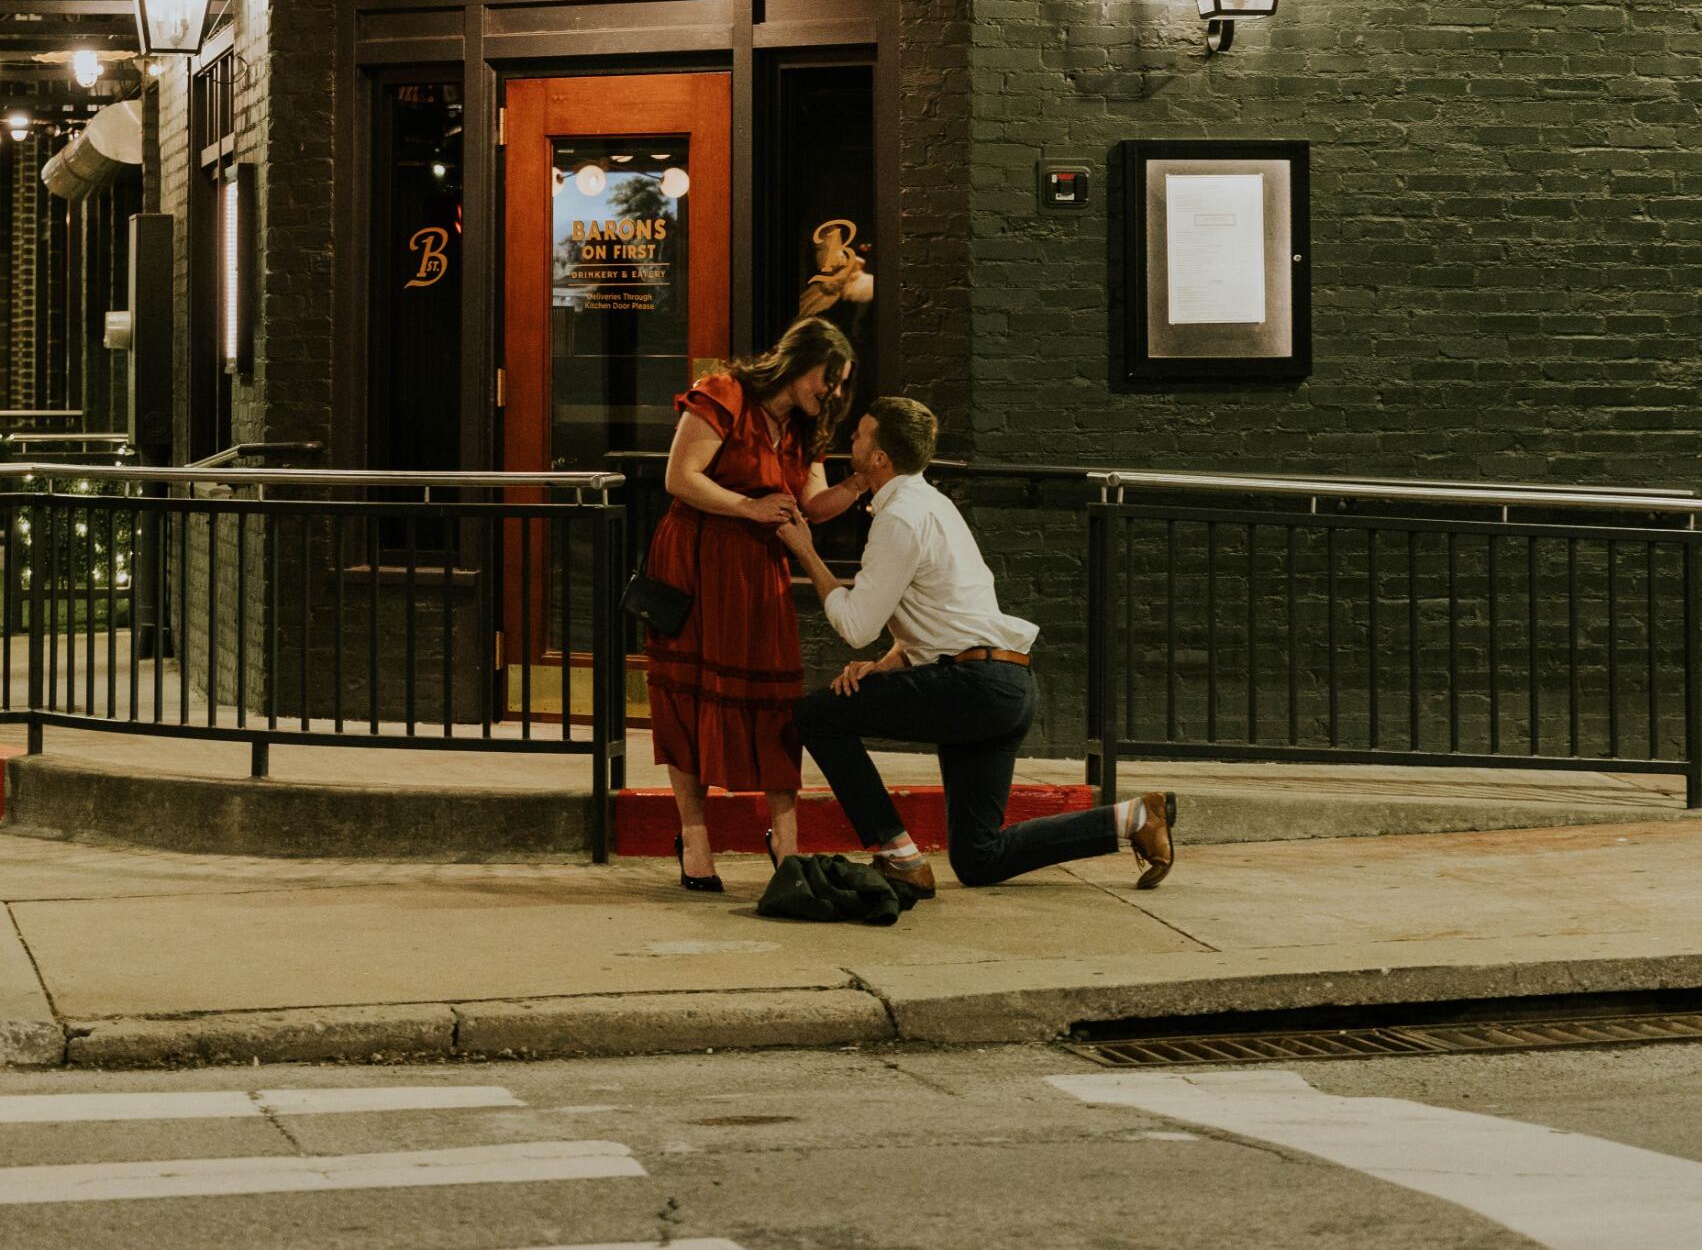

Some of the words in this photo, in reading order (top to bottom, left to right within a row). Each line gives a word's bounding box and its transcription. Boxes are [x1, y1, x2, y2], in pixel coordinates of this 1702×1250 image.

[571, 218, 667, 240] BARONS
[404, 226, 449, 289] B
[582, 245, 606, 260] ON
[613, 244, 656, 259] FIRST
[571, 270, 618, 279] DRINKERY
[632, 270, 666, 278] EATERY
[586, 293, 622, 301] Deliveries
[622, 292, 652, 302] Through
[631, 302, 655, 310] Please
